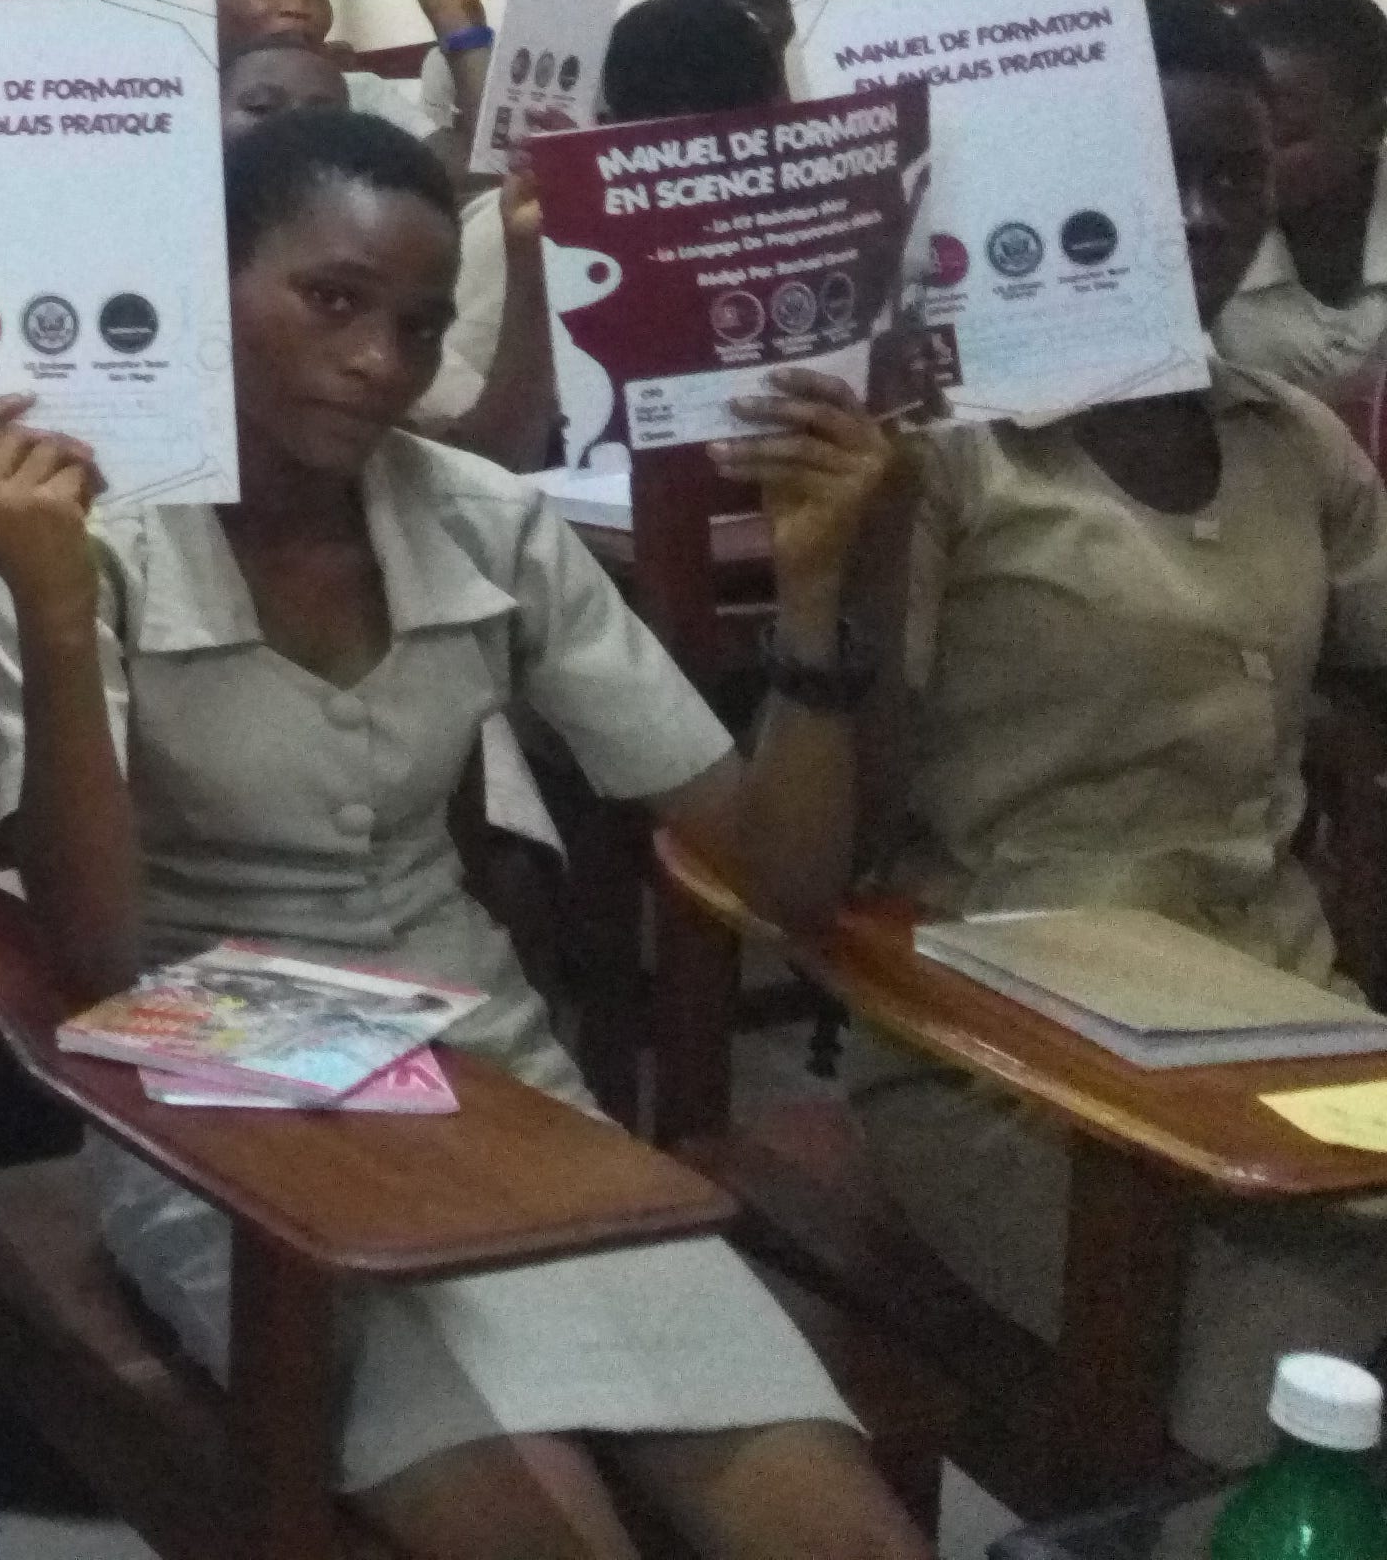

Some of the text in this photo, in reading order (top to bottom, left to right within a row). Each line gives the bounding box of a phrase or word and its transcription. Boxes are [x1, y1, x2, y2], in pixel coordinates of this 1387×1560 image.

[834, 8, 1112, 69] MANUEL DE FORMATION
[3, 79, 35, 100] DE
[42, 76, 184, 101] FORMATION
[854, 41, 1104, 93] EN ANGLAIS PRATIQUE
[59, 112, 172, 136] PRATIQUE
[597, 104, 897, 180] MANUEL DE FORMATION
[604, 140, 896, 215] EN SCIENCE ROBOTIQUE
